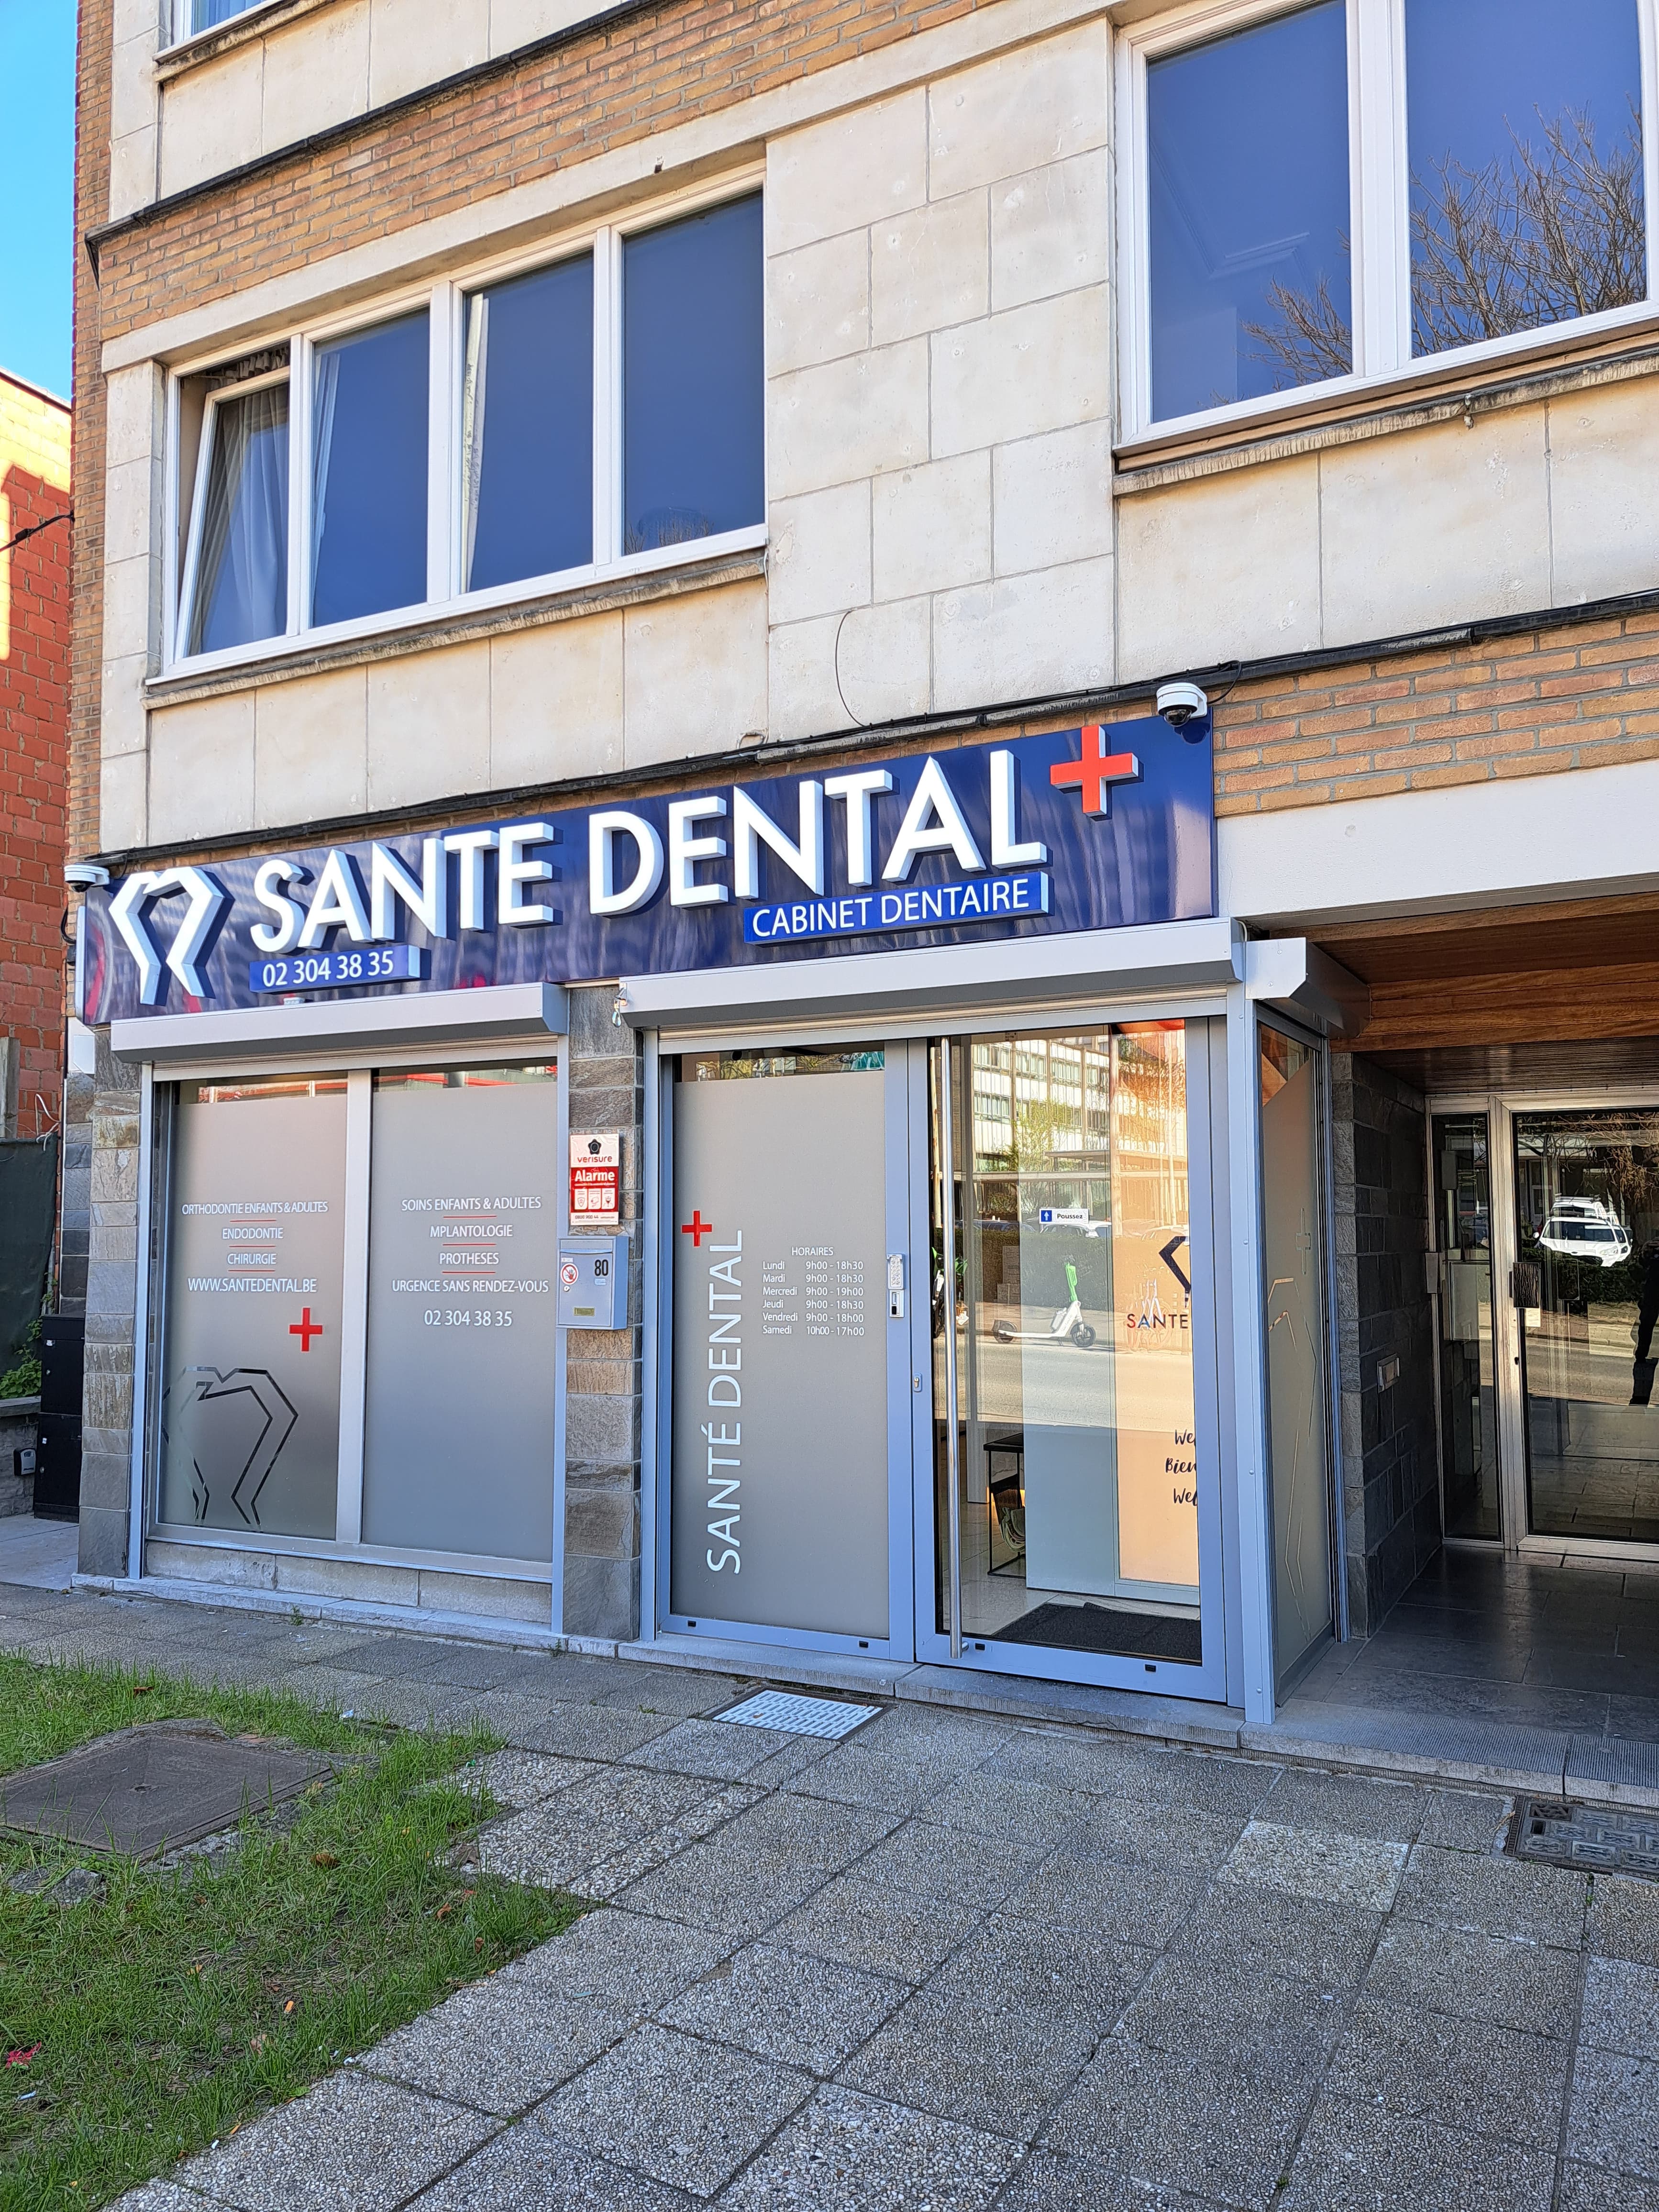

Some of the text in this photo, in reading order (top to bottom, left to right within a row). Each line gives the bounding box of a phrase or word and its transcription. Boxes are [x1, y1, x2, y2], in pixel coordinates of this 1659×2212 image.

[251, 750, 1047, 954] SANTE DENTAL
[752, 879, 1029, 937] CABINET DENTAIRE
[263, 950, 394, 986] 02 304 38 35
[575, 1169, 615, 1182] Alarme
[182, 1203, 243, 1215] ORTHODONTIE
[245, 1202, 283, 1214] ENFANTS
[291, 1202, 328, 1212] ADULTES
[402, 1197, 541, 1211] SOINS ENFANTS & ADULTES
[222, 1228, 283, 1239] ENDODONTIE
[792, 1247, 834, 1256] HORAIRES
[227, 1253, 276, 1264] CHIRURGIE
[440, 1253, 499, 1265] PROTHESES
[595, 1259, 608, 1276] 80
[763, 1261, 785, 1270] Lundi
[837, 1261, 863, 1270] 18h30
[763, 1274, 785, 1283] Mardi
[837, 1274, 863, 1283] 18h30
[188, 1279, 317, 1292] WWW.SANTEDENTAL.BE
[392, 1280, 549, 1292] URGENCE SANS RENDEZ-VOUS
[763, 1287, 797, 1295] Mercredi
[806, 1287, 828, 1295] 9h00
[837, 1287, 863, 1295] 19h00
[763, 1300, 784, 1308] Jeudi
[806, 1301, 828, 1309] 9h00
[837, 1301, 863, 1309] 18h30
[424, 1310, 512, 1327] 02 304 38 35
[763, 1313, 797, 1321] Vendredi
[806, 1314, 828, 1322] 9h00
[837, 1314, 863, 1322] 18h00
[1127, 1314, 1188, 1329] SANTE
[763, 1325, 792, 1334] Samedi
[807, 1327, 830, 1335] 10h00
[837, 1327, 864, 1335] 17h00
[701, 1230, 742, 1574] SANTÉ DENTAL
